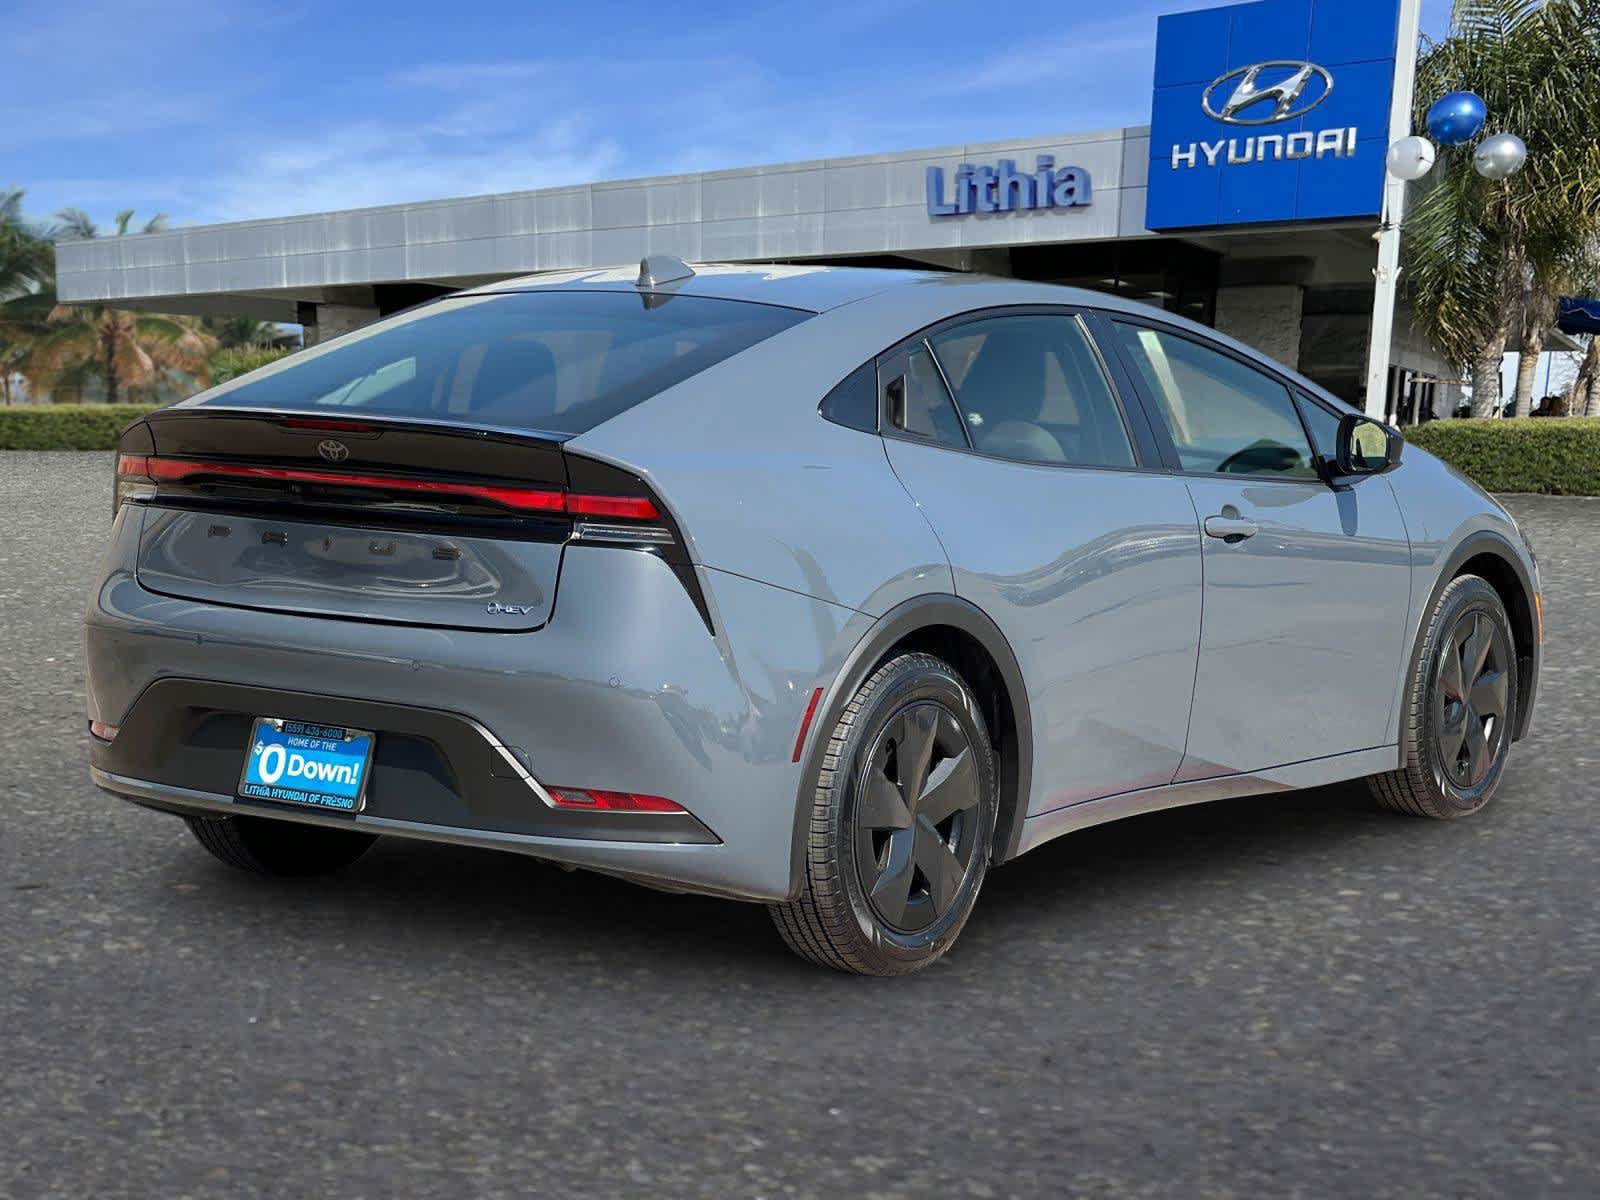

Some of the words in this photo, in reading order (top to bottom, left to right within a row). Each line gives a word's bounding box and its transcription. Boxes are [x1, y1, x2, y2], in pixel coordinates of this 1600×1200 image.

[1170, 127, 1358, 169] HYUNDAI
[926, 154, 1093, 216] Lithia
[286, 723, 305, 732] (559)
[287, 736, 308, 748] HOME
[309, 740, 321, 748] OF
[322, 742, 337, 752] THE
[287, 754, 359, 785] Down!
[244, 784, 270, 797] LITHIA
[271, 788, 308, 802] HYUNDAI
[309, 794, 321, 804] OF
[320, 795, 354, 809] FRESNO
